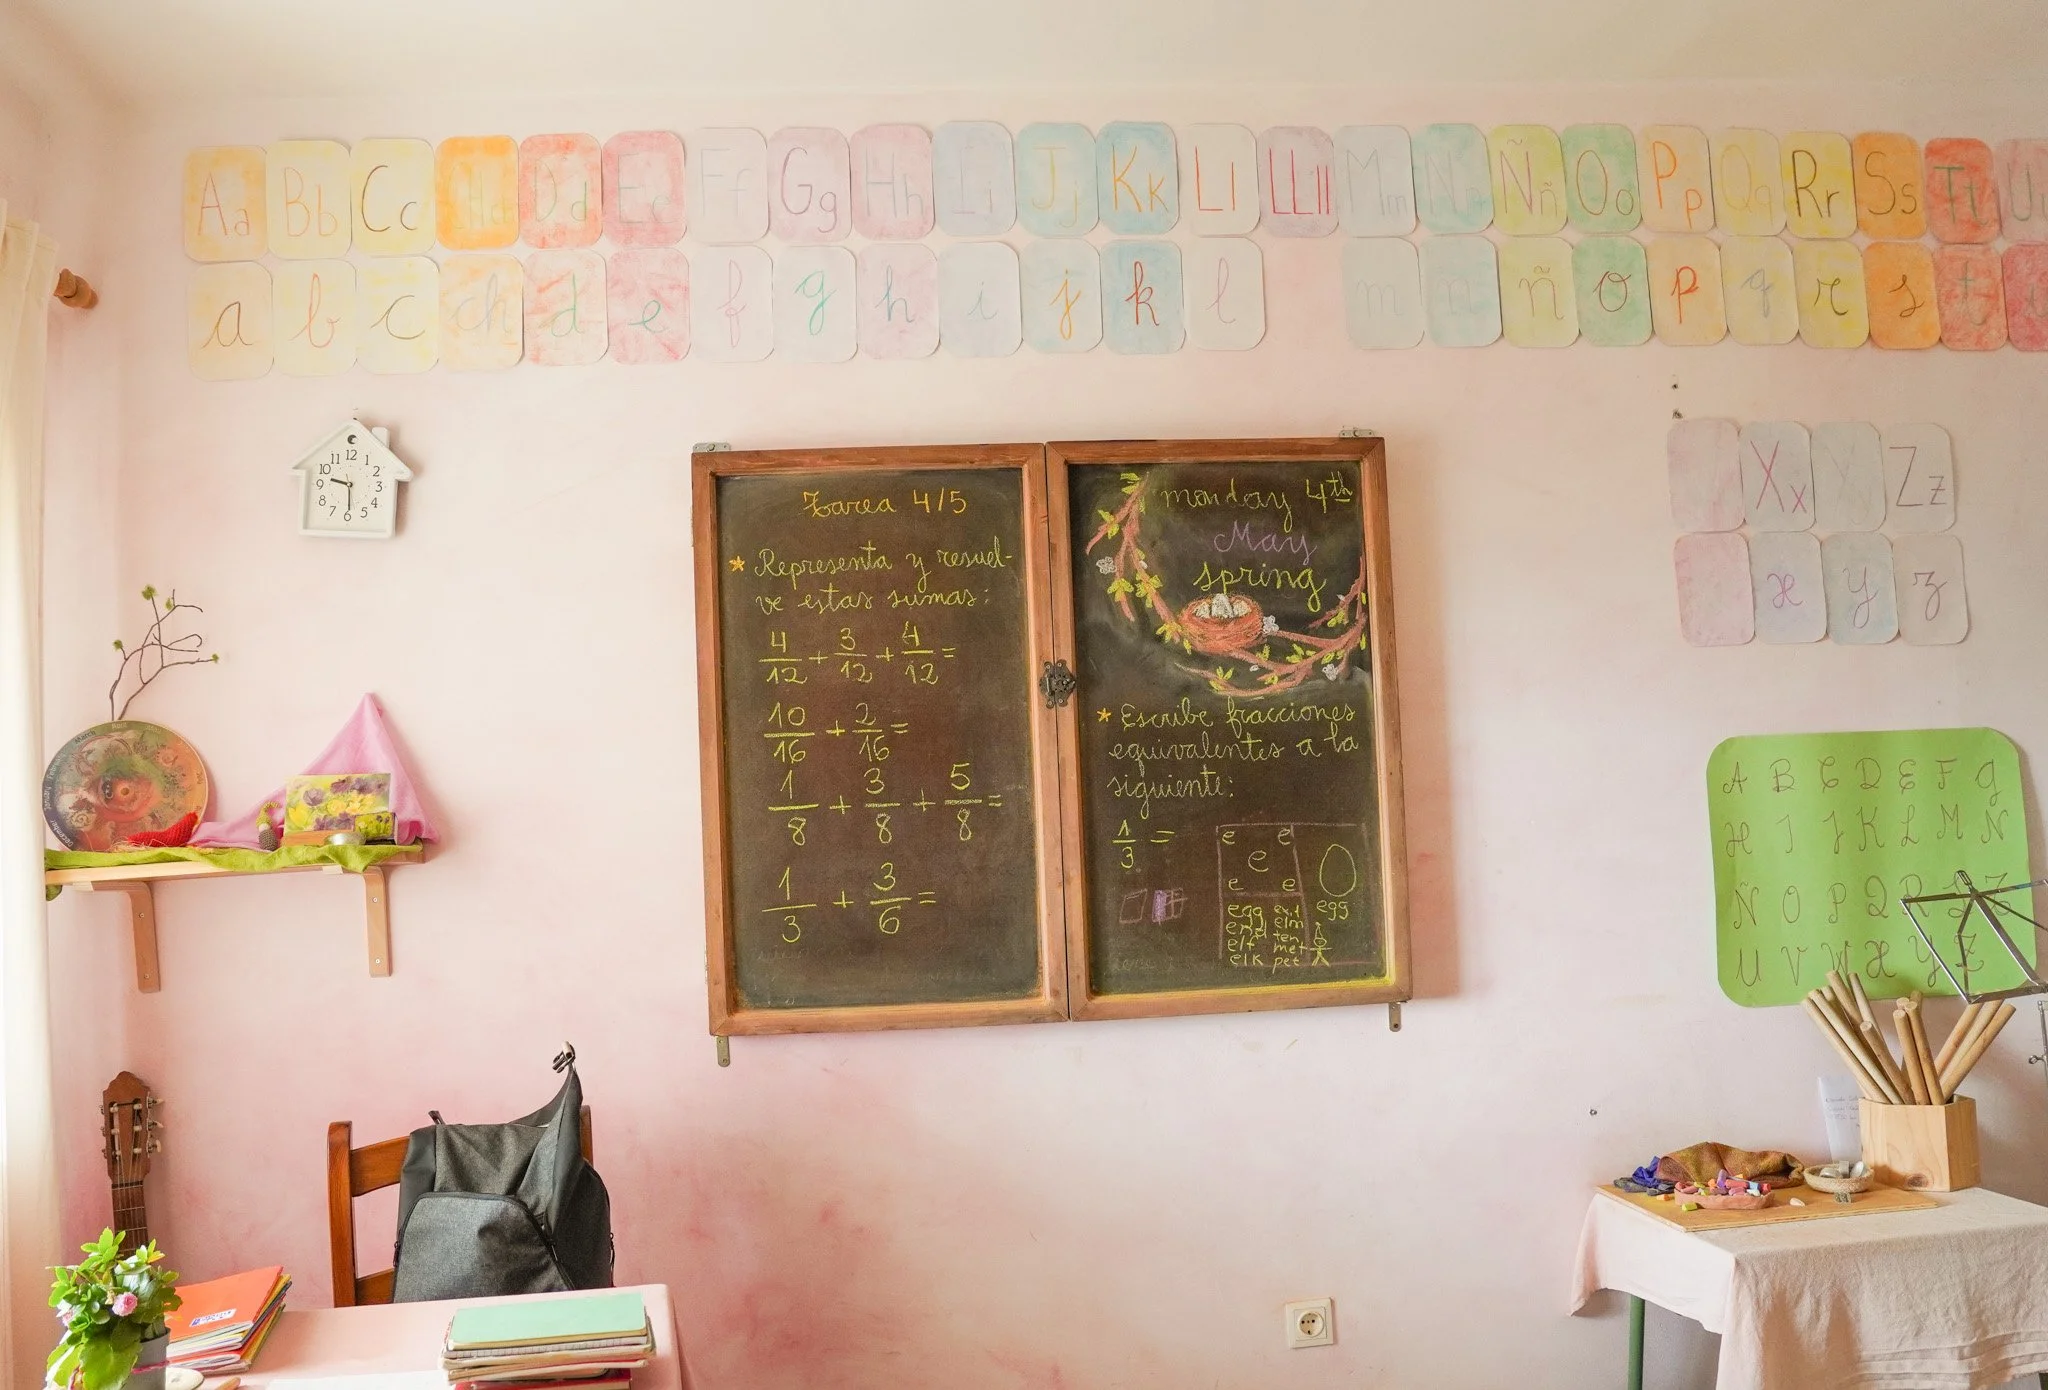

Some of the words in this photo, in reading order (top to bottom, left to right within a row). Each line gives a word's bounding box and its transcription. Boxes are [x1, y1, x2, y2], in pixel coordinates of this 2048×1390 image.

[197, 173, 250, 236] Aa
[283, 167, 338, 236] Bb
[361, 165, 418, 232] Cc
[535, 159, 587, 223] Dd
[701, 149, 752, 217] Ff
[781, 147, 837, 233] Gg
[866, 146, 924, 218] Hh
[1031, 146, 1078, 228] Jj
[1113, 145, 1169, 213] Kk
[1347, 149, 1408, 215] Mm
[1500, 138, 1558, 218] Ññ
[1576, 150, 1634, 215] Oo
[1652, 140, 1702, 230] Pp
[1720, 144, 1773, 225] Qq
[1791, 150, 1840, 218] Rr
[1865, 151, 1917, 216] Ss
[201, 302, 253, 348] a
[289, 274, 340, 348] b
[370, 295, 425, 339] c
[448, 273, 511, 334] ch
[540, 273, 584, 337] d
[628, 300, 667, 333] e
[717, 259, 747, 348] f
[793, 270, 837, 336] g
[875, 264, 914, 323] h
[967, 280, 997, 320] i
[1049, 268, 1082, 341] j
[1124, 261, 1159, 326] k
[1356, 279, 1403, 318] m
[1436, 278, 1478, 315] n
[1519, 265, 1564, 320] ñ
[1592, 271, 1631, 312] o
[1670, 266, 1699, 324] p
[1740, 268, 1774, 319] q
[1813, 276, 1849, 317] r
[1888, 274, 1925, 318] s
[331, 454, 340, 464] 11
[346, 450, 357, 460] 12
[365, 455, 369, 465] 1
[320, 464, 331, 474] 10
[373, 466, 380, 477] 2
[1750, 440, 1807, 513] Xx
[1889, 446, 1947, 506] Zz
[316, 479, 324, 489] 9
[376, 481, 382, 492] 3
[1306, 471, 1353, 513] 4th
[319, 495, 326, 506] 8
[329, 506, 336, 516] 7
[361, 507, 367, 518] 5
[371, 498, 377, 508] 4
[913, 488, 966, 513] 4/5
[344, 510, 351, 521] 6
[1214, 520, 1317, 565] May
[754, 540, 893, 590] Representa
[906, 552, 931, 592] y
[936, 536, 1012, 568] resuel-
[756, 595, 784, 615] ve
[798, 582, 872, 614] estas
[888, 588, 990, 608] sumas:
[1767, 573, 1803, 609] x
[1843, 565, 1878, 629] y
[1913, 571, 1948, 621] z
[771, 631, 786, 652] 4
[839, 628, 855, 650] 3
[902, 621, 920, 646] 4
[766, 666, 808, 684] 12
[840, 664, 872, 683] 12
[905, 661, 938, 684] 12
[768, 702, 806, 728] 10
[855, 703, 876, 725] 2
[1121, 697, 1213, 731] Escribe
[1226, 697, 1355, 738] fracciones
[74, 730, 96, 744] March
[774, 739, 806, 763] 16
[859, 735, 890, 761] 16
[1109, 731, 1284, 777] equivalentes
[1296, 738, 1321, 757] a
[1324, 722, 1358, 752] la
[780, 770, 793, 799] 1
[864, 768, 885, 794] 3
[950, 763, 970, 790] 5
[1723, 762, 1747, 794] A
[1770, 759, 1795, 792] B
[1818, 756, 1838, 793] C
[1856, 757, 1881, 789] D
[1900, 759, 1916, 794] E
[1936, 759, 1957, 789] F
[1107, 764, 1234, 819] siguiente:
[788, 817, 806, 846] 8
[876, 813, 892, 844] 8
[957, 808, 972, 840] 8
[1222, 830, 1236, 845] e
[1278, 828, 1291, 845] e
[1724, 822, 1752, 857] H
[1856, 807, 1884, 851] K
[1901, 804, 1919, 847] L
[1937, 804, 1962, 839] M
[1981, 810, 2008, 843] N
[1121, 847, 1134, 869] 3
[779, 867, 789, 900] 1
[874, 863, 895, 891] 3
[1228, 877, 1244, 890] e
[1282, 878, 1296, 891] e
[1317, 900, 1348, 921] egg
[1734, 882, 1759, 929] Ñ
[1783, 886, 1800, 923] O
[1829, 883, 1846, 923] P
[1899, 874, 1929, 918] R
[782, 916, 800, 942] 3
[879, 906, 901, 934] 6
[1228, 904, 1264, 929] egg
[1275, 917, 1304, 928] elm
[1226, 920, 1266, 938] end
[1273, 931, 1299, 942] ten
[1228, 935, 1258, 952] elf
[1274, 942, 1308, 955] met
[1272, 957, 1299, 974] pet
[1736, 949, 1761, 986] U
[1781, 947, 1807, 985] V
[1865, 940, 1897, 979] X
